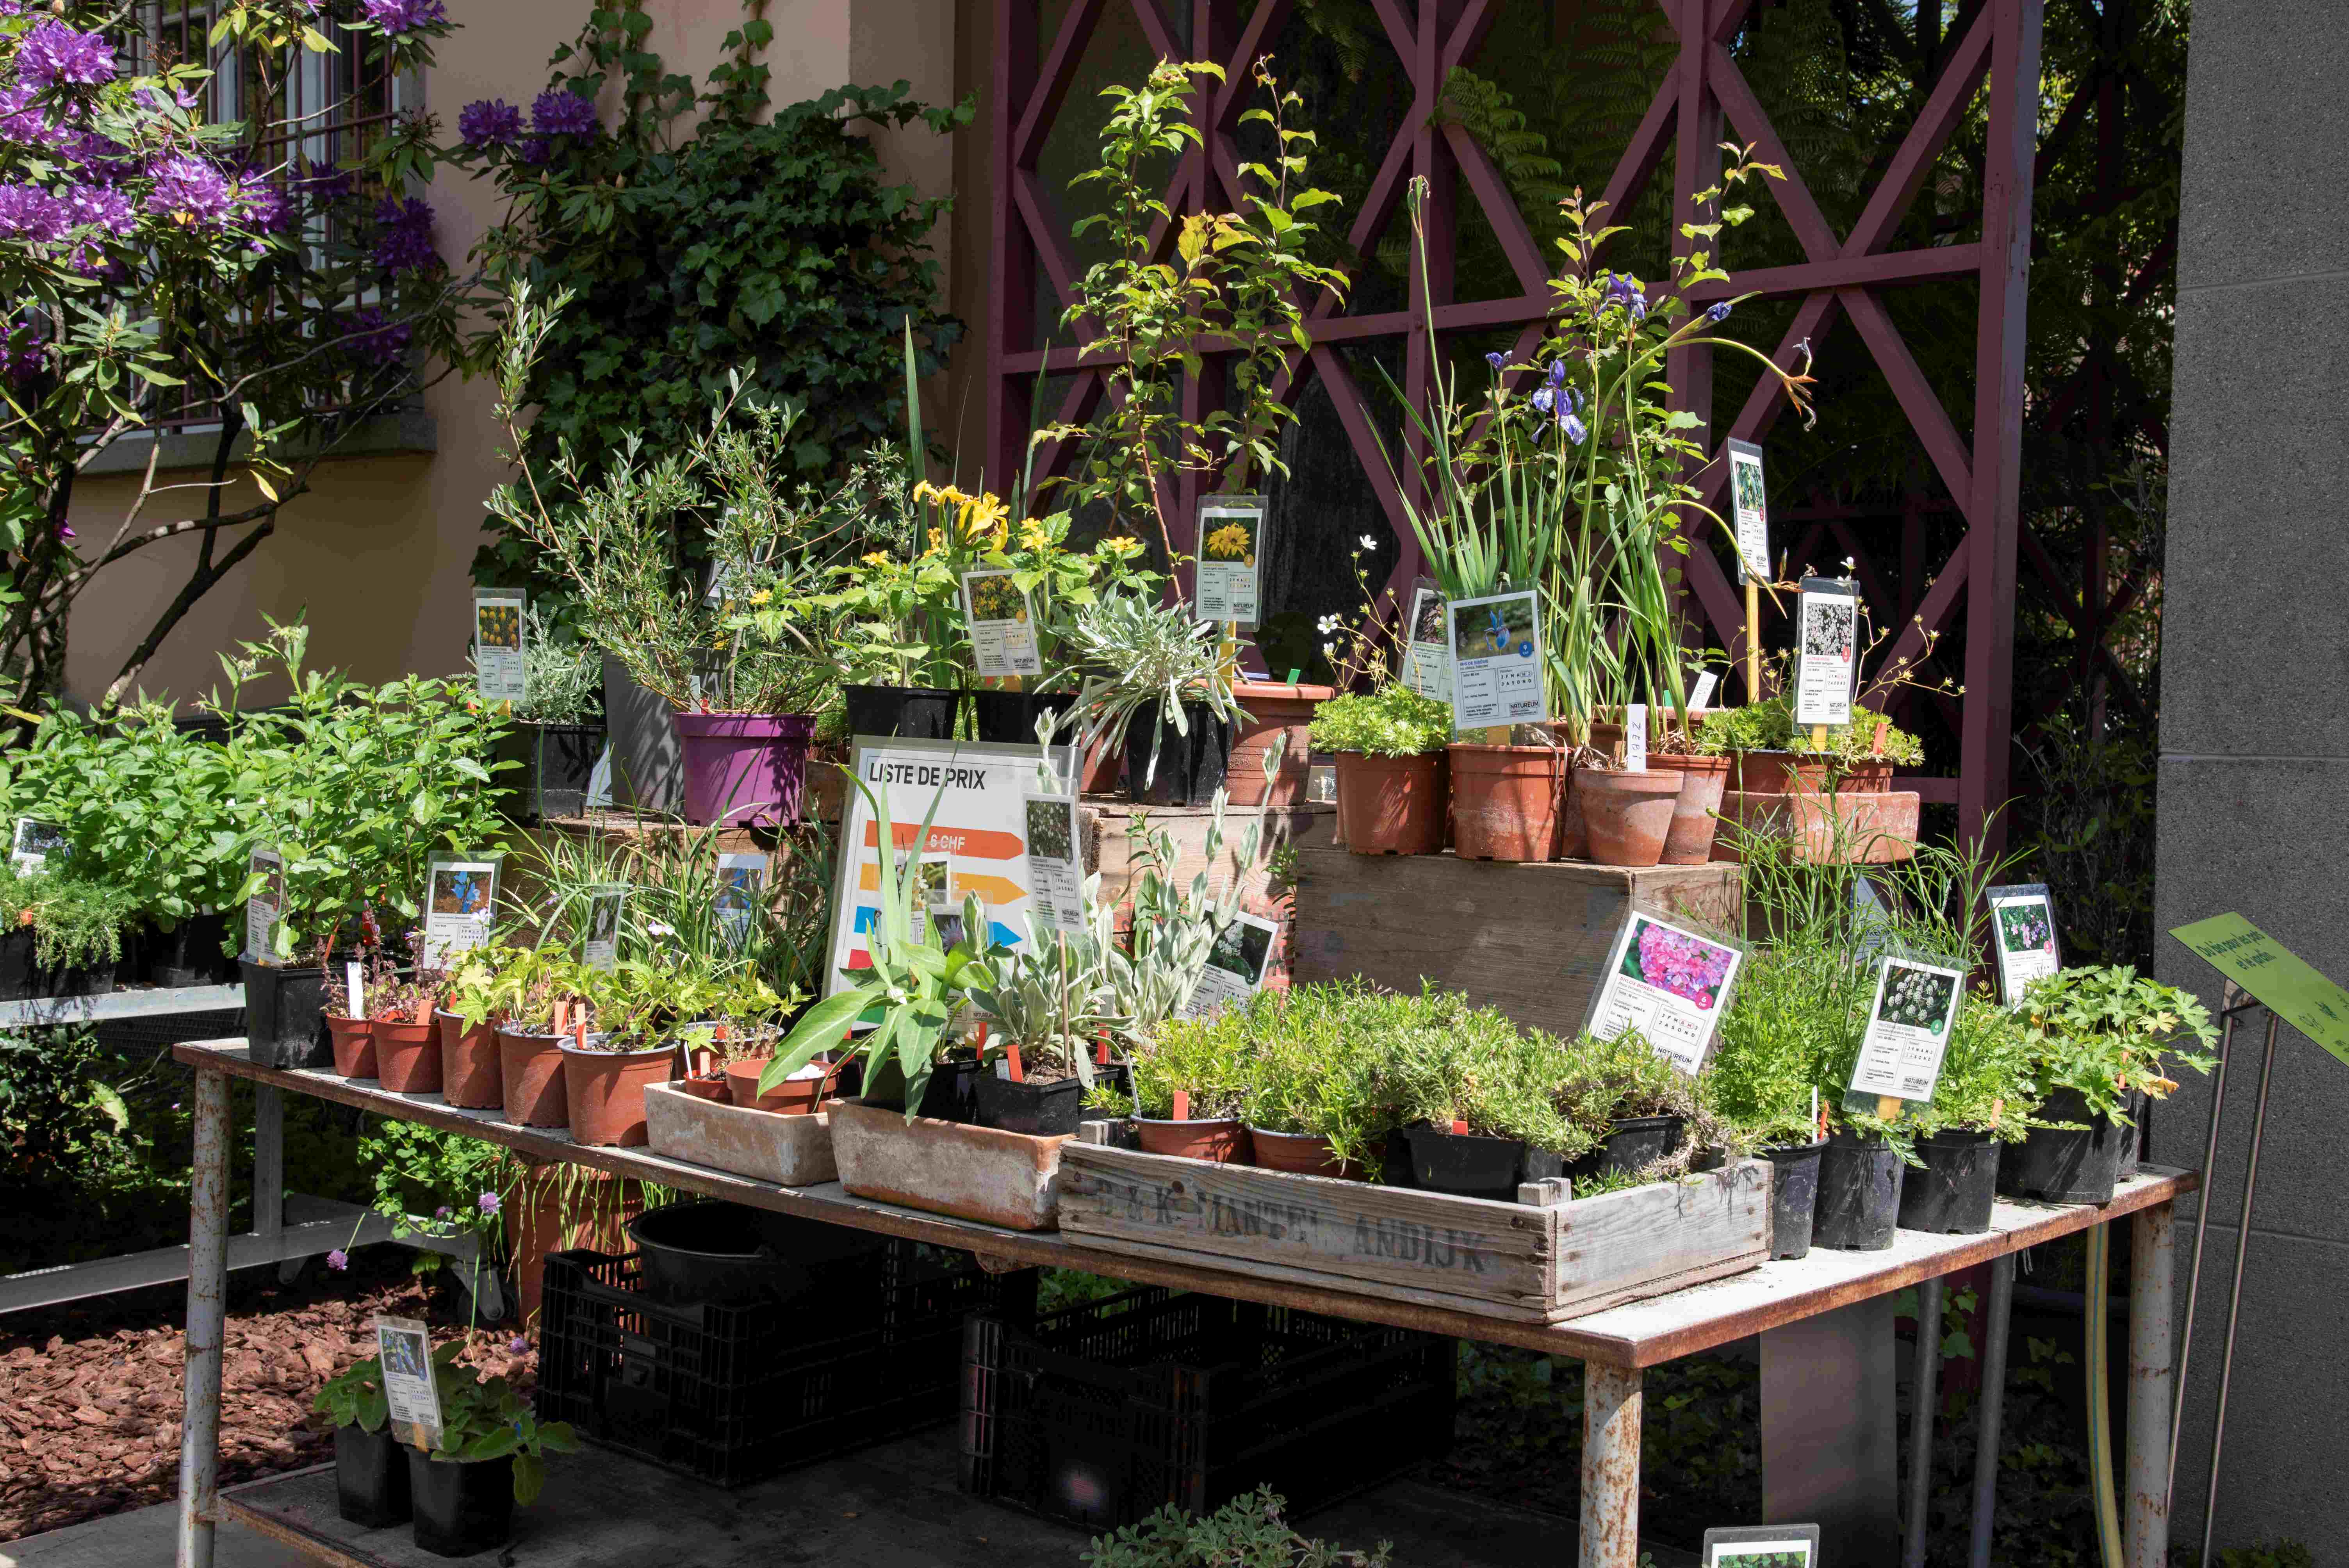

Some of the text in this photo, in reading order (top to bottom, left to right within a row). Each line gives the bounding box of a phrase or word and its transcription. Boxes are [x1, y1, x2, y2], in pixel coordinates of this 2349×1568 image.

[870, 763, 987, 790] LISTE DE PRIX
[930, 834, 965, 850] 6 CHF
[1620, 977, 1656, 994] PHLOX BORÉAL
[1657, 1046, 1693, 1065] NATURÉUM
[1354, 1212, 1486, 1273] ANDIJK
